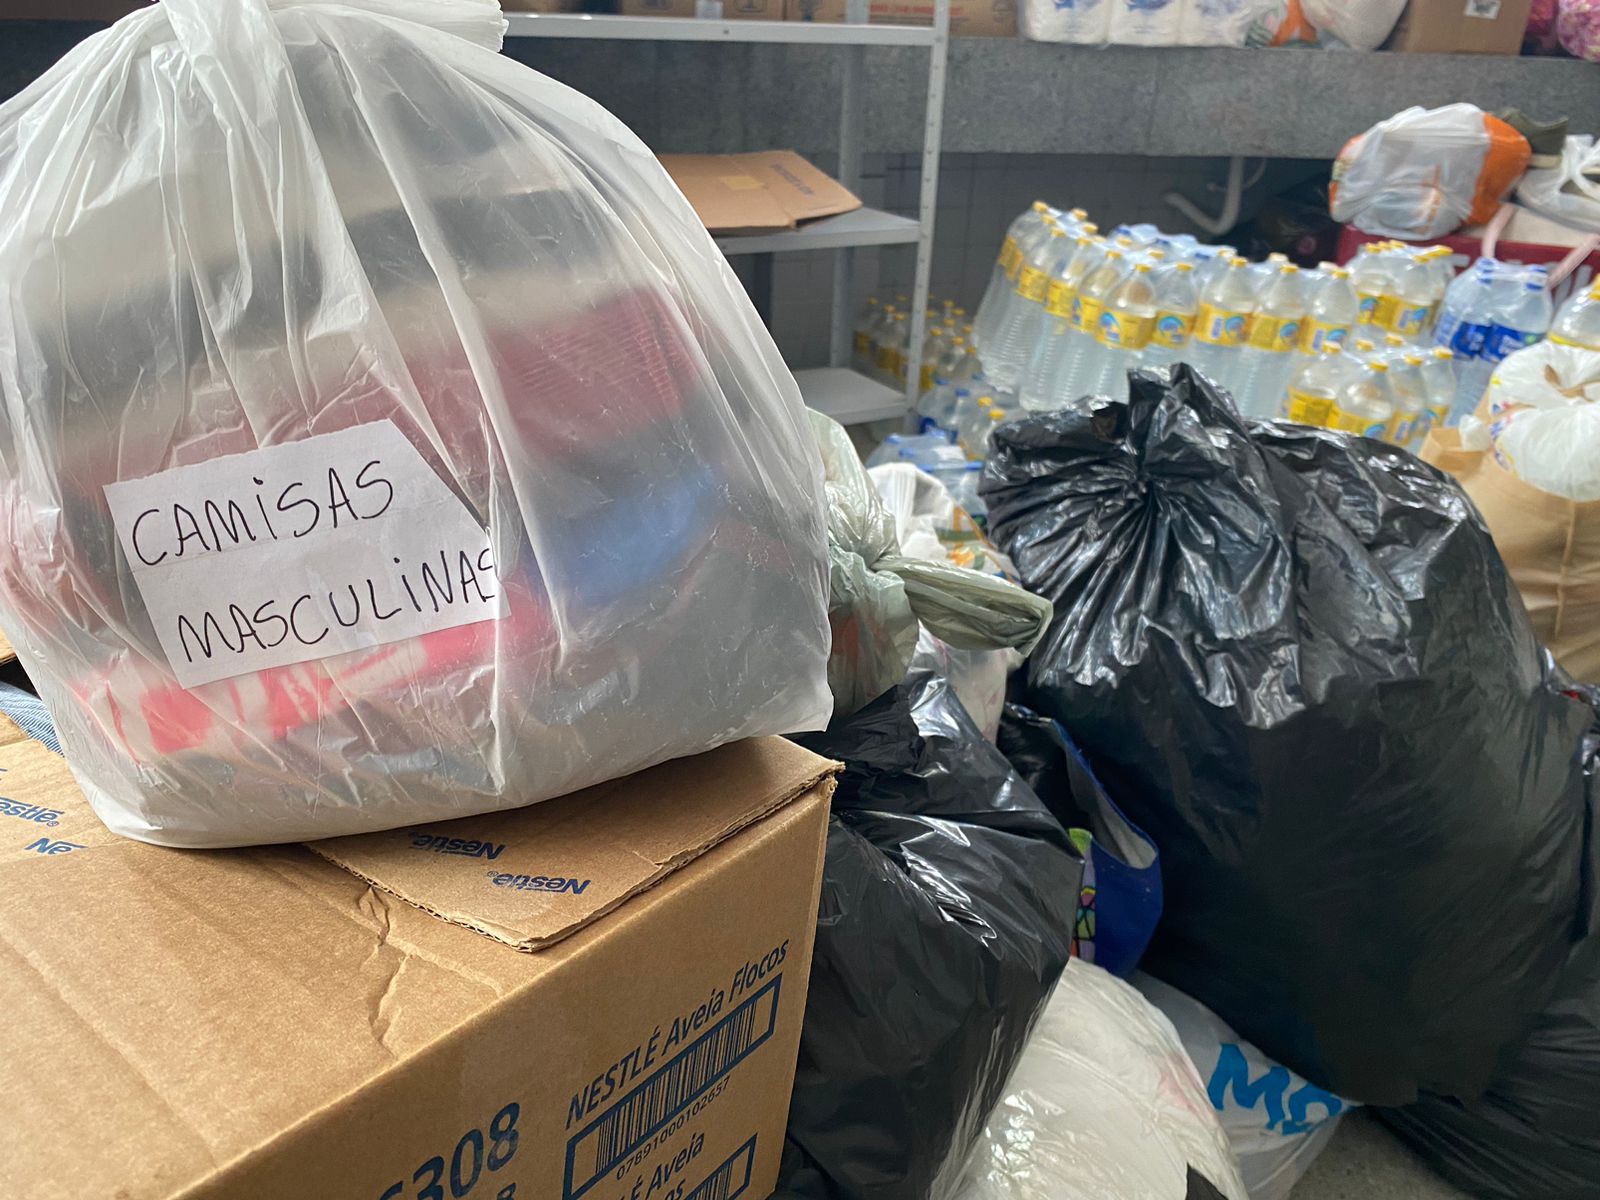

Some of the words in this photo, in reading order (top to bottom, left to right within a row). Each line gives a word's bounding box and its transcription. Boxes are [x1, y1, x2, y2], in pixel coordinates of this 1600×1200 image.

[565, 1025, 661, 1131] NESTLÉ
[661, 988, 725, 1057] Aveia
[728, 938, 790, 1004] Flocos
[379, 1102, 521, 1200] 308
[616, 1075, 731, 1181] 07891000102657
[646, 1132, 706, 1200] Aveia
